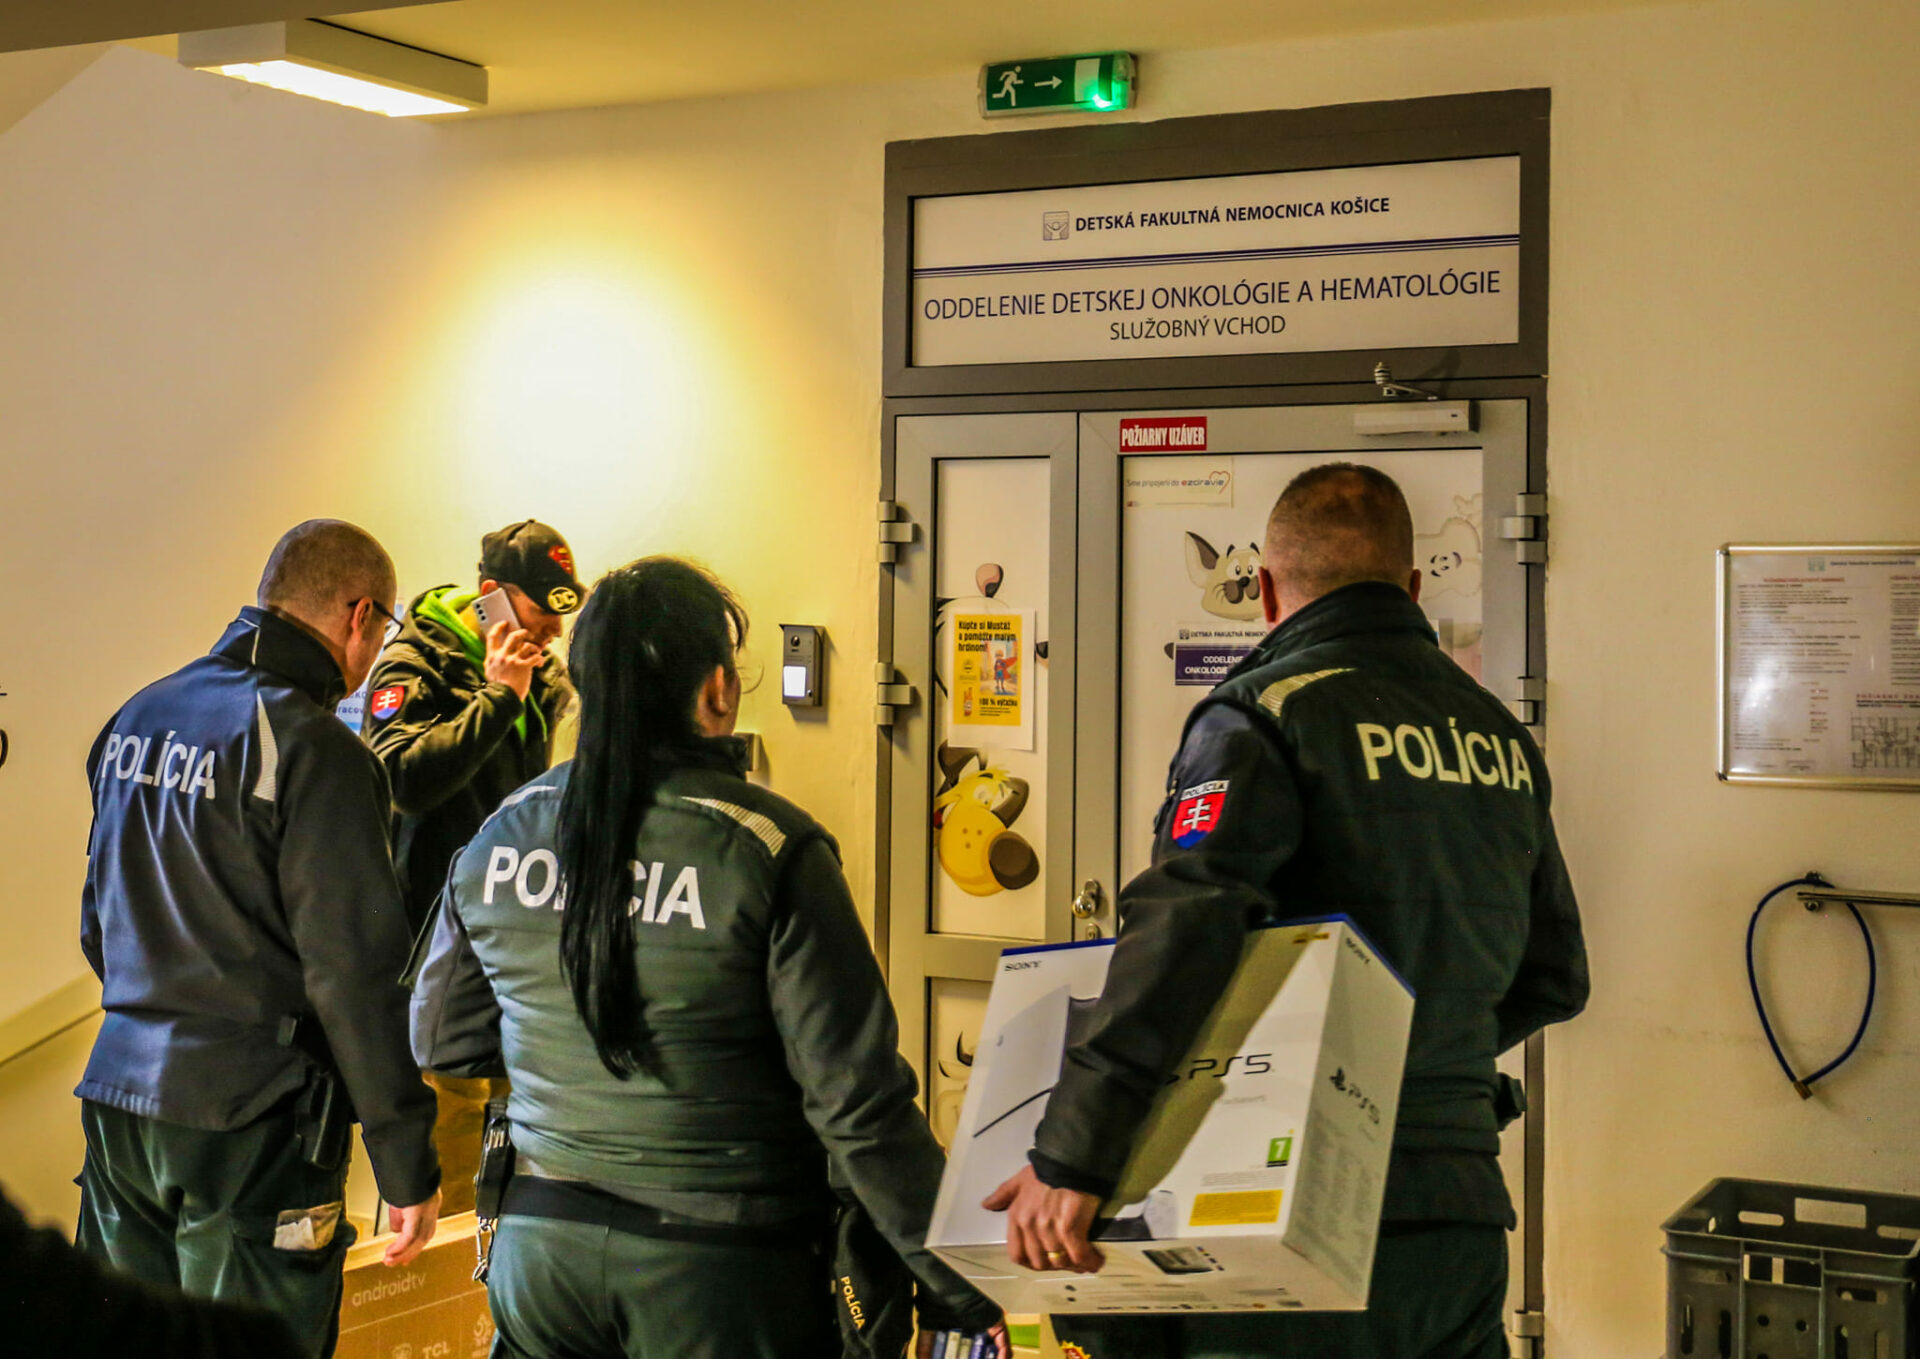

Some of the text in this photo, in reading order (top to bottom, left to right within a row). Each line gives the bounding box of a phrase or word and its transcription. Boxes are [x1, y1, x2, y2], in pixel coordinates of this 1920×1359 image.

[1076, 196, 1390, 231] DETSKÁ FAKULTNÁ NEMOCNICA KOŠICE
[924, 268, 1500, 320] ODDELENIE DETSKEJ ONKOLÓGIE A HEMATOLÓGIE
[1110, 315, 1286, 341] SLUŽOBNÝ VCHOD
[1121, 423, 1205, 447] POŽIARNY UZÁVER
[548, 589, 578, 610] DC
[101, 730, 215, 799] POLÍCIA
[1356, 717, 1533, 795] POLÍCIA
[483, 846, 706, 929] POCIA
[1004, 960, 1042, 971] SONY
[1188, 1053, 1272, 1080] PS5
[841, 1276, 866, 1329] POLÍCIA
[422, 1341, 451, 1359] TCL
